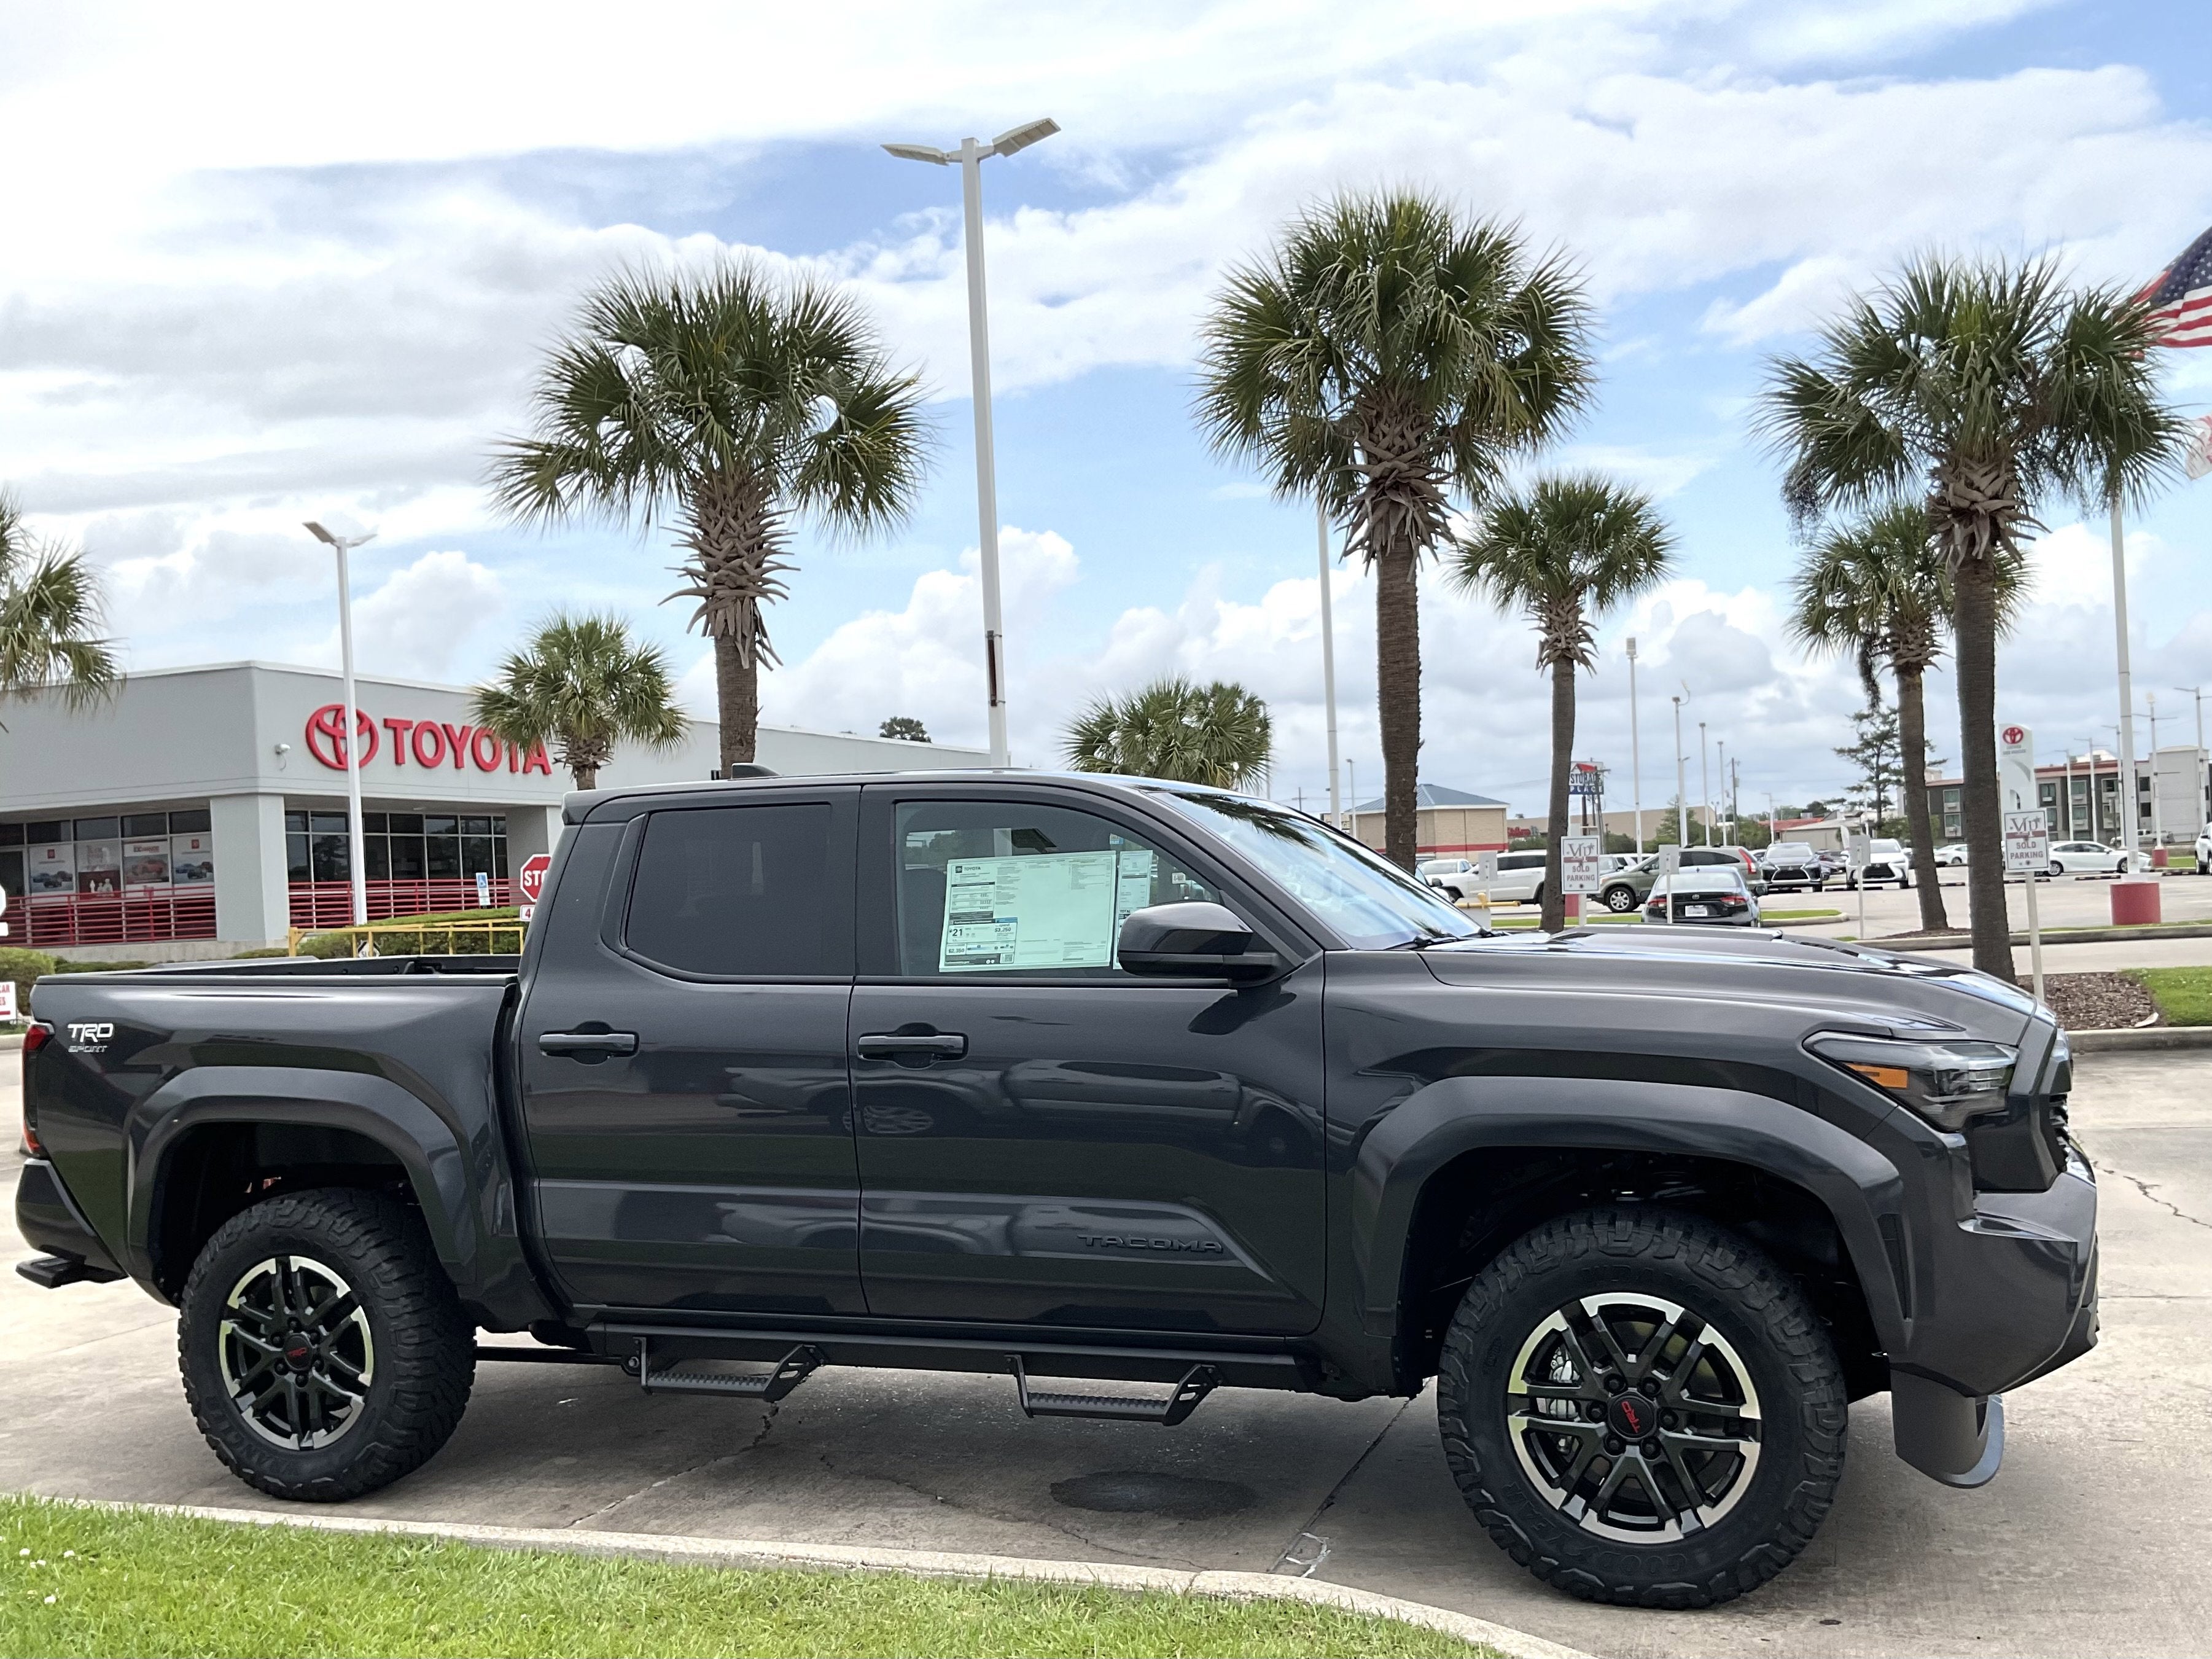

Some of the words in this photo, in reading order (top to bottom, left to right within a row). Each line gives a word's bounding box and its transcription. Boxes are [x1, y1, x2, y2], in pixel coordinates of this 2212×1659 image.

[1570, 773, 1602, 784] STORA
[2016, 841, 2036, 849] SOLD
[2010, 851, 2044, 859] PARKING
[524, 870, 548, 886] ST
[952, 928, 963, 937] 21
[0, 984, 10, 993] AR
[67, 1023, 114, 1043] TRD
[1077, 1233, 1224, 1254] TACOMA
[1621, 1400, 1640, 1434] TRD
